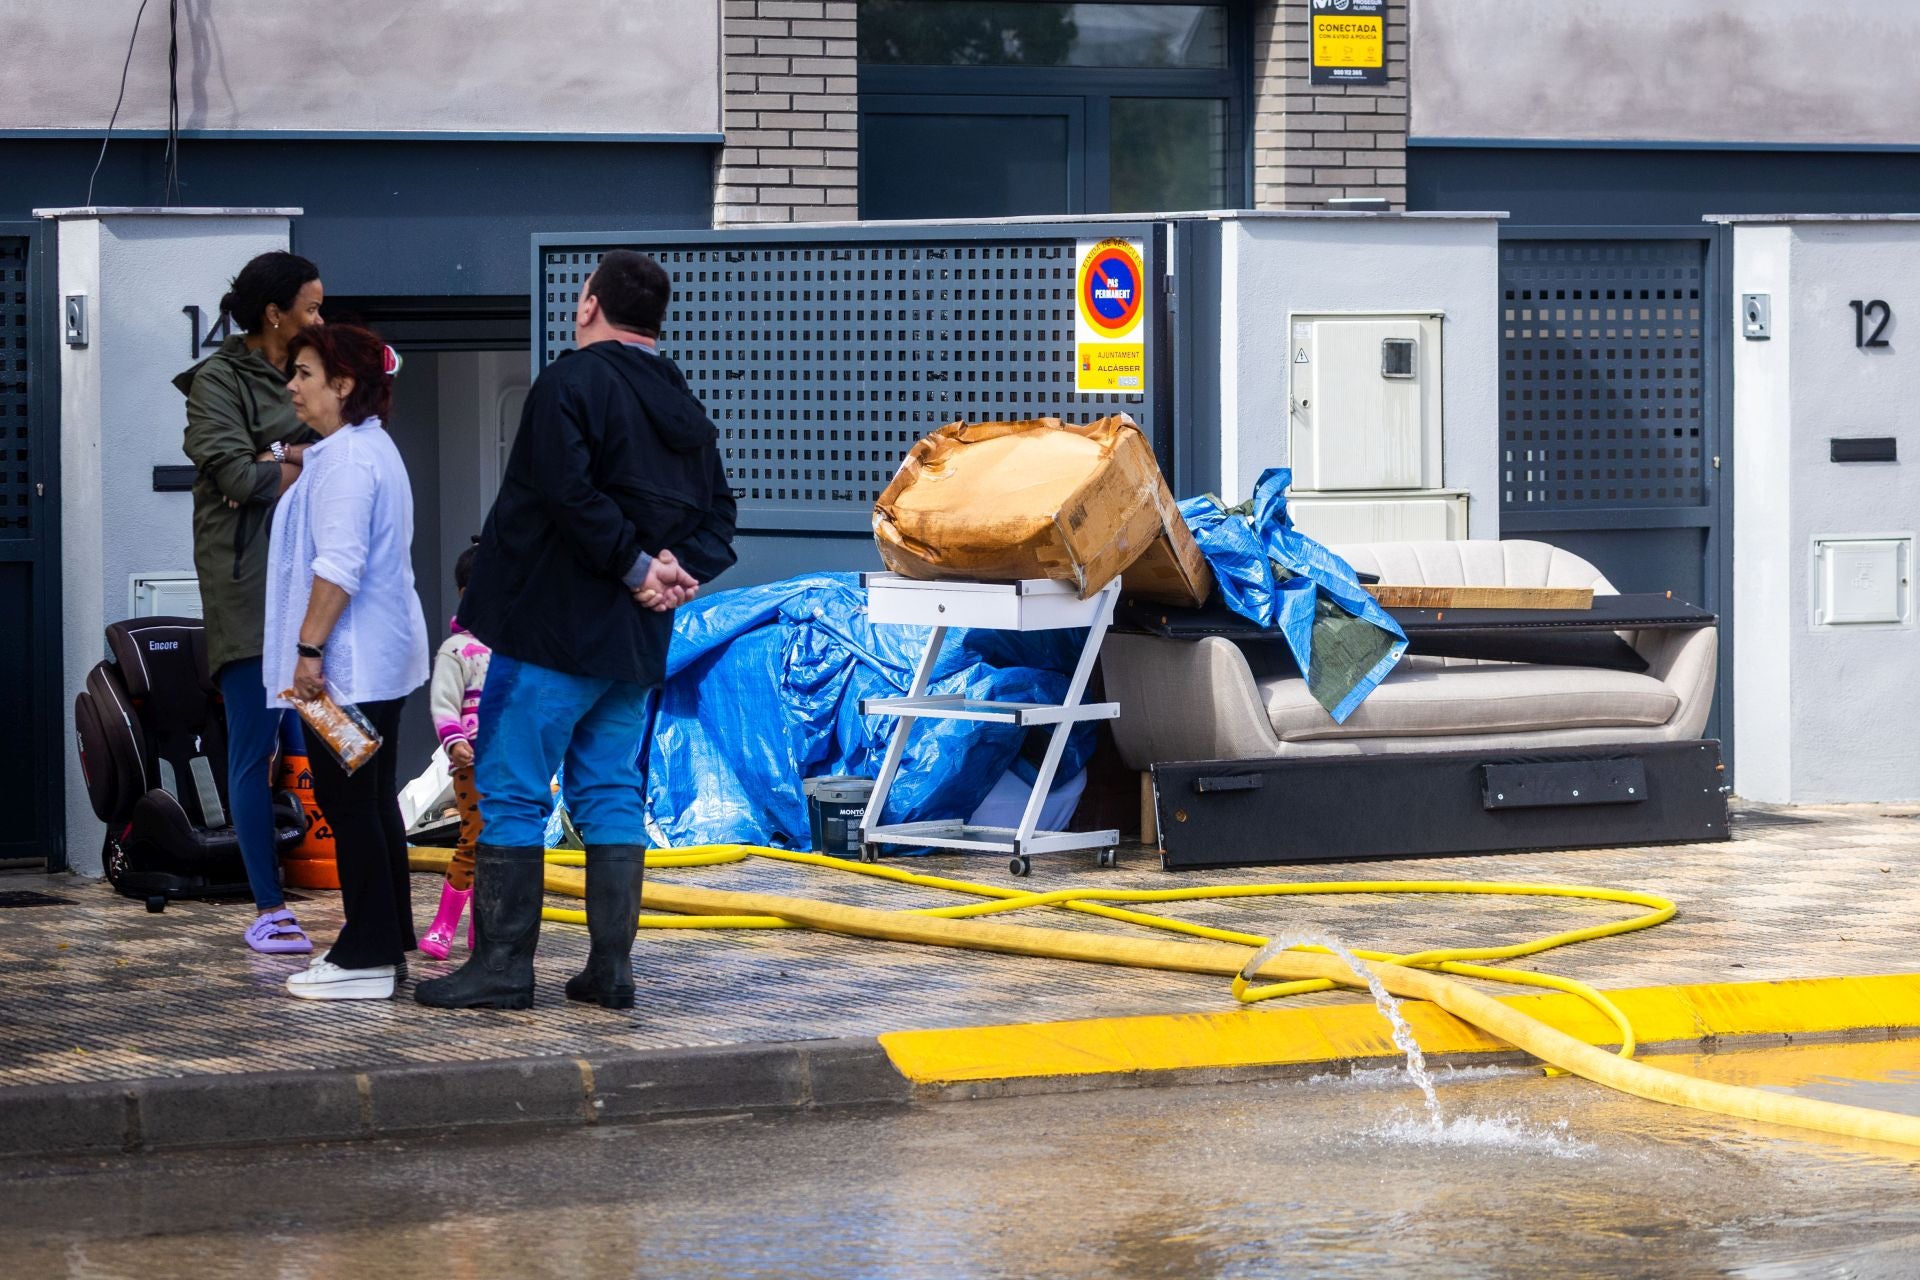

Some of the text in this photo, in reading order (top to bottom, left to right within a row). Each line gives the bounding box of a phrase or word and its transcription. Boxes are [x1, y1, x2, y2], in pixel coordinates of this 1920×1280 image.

[1319, 24, 1377, 32] CONECTADA
[1101, 239, 1112, 247] DE
[1107, 278, 1119, 288] PAS
[1095, 289, 1131, 299] PERMANENT
[1848, 299, 1891, 348] 12
[1097, 351, 1140, 359] AJUNTAMENT
[149, 640, 179, 651] Encore
